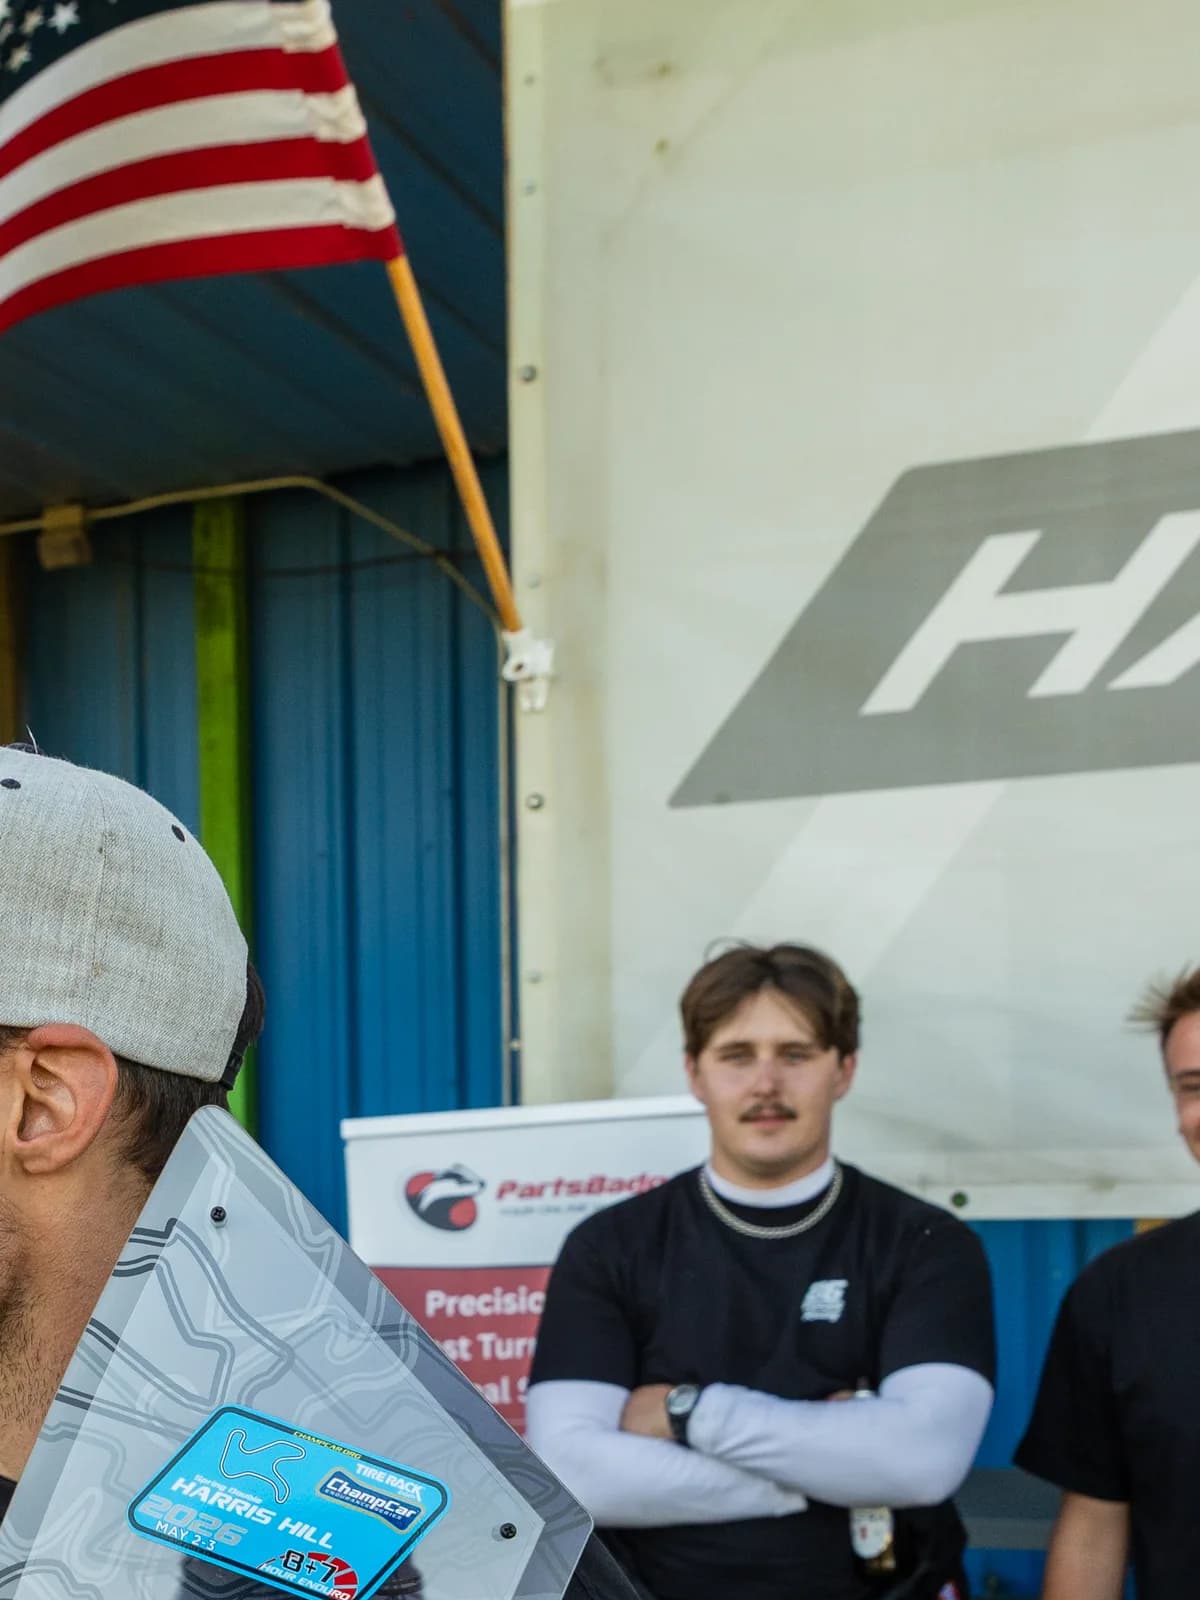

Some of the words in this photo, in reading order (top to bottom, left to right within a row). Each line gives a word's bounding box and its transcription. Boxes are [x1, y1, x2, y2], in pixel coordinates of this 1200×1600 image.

[434, 1335, 472, 1361] st
[474, 1376, 512, 1405] al
[326, 1478, 417, 1518] ChampCar
[356, 1463, 386, 1483] TIRE
[385, 1475, 422, 1502] RACK
[139, 1494, 248, 1546] 2026
[170, 1477, 277, 1525] HARRIS
[278, 1517, 332, 1549] HILL
[325, 1489, 369, 1508] ENDURANCE
[374, 1507, 402, 1520] SERIES
[155, 1520, 189, 1540] MAY
[192, 1534, 217, 1551] 2-3
[260, 1563, 297, 1581] HOUR
[297, 1577, 351, 1600] ENDURO
